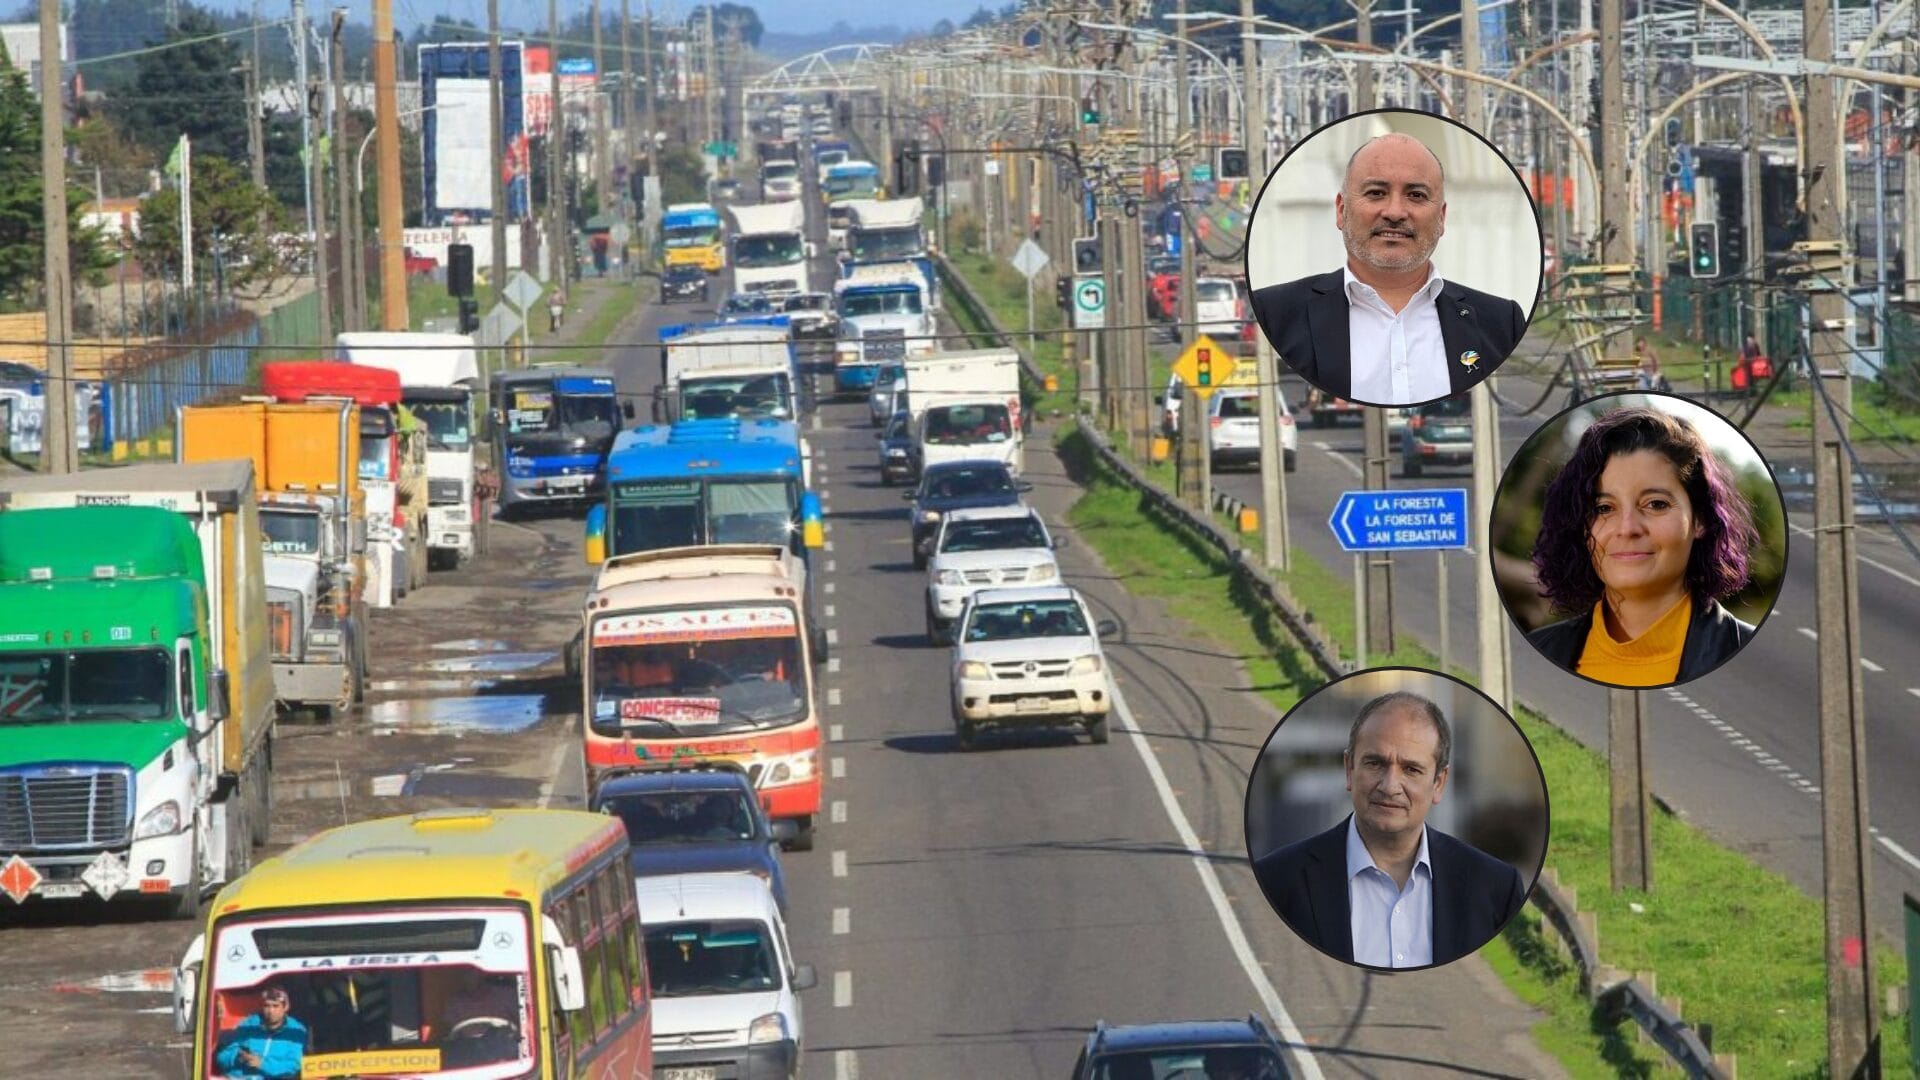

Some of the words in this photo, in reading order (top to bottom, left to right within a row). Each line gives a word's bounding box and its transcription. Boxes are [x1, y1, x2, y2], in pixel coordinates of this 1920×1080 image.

[1374, 498, 1390, 510] LA
[1394, 497, 1445, 509] FORESTA
[1365, 515, 1380, 527] LA
[1384, 514, 1436, 525] FORESTA
[1440, 512, 1455, 524] DE
[1367, 531, 1390, 543] SAN
[1395, 530, 1457, 542] SEBASTIAN
[600, 617, 664, 633] LOS
[623, 700, 718, 717] CONCEPCION
[301, 958, 333, 969] LA
[304, 1055, 437, 1073] CONCEPCION
